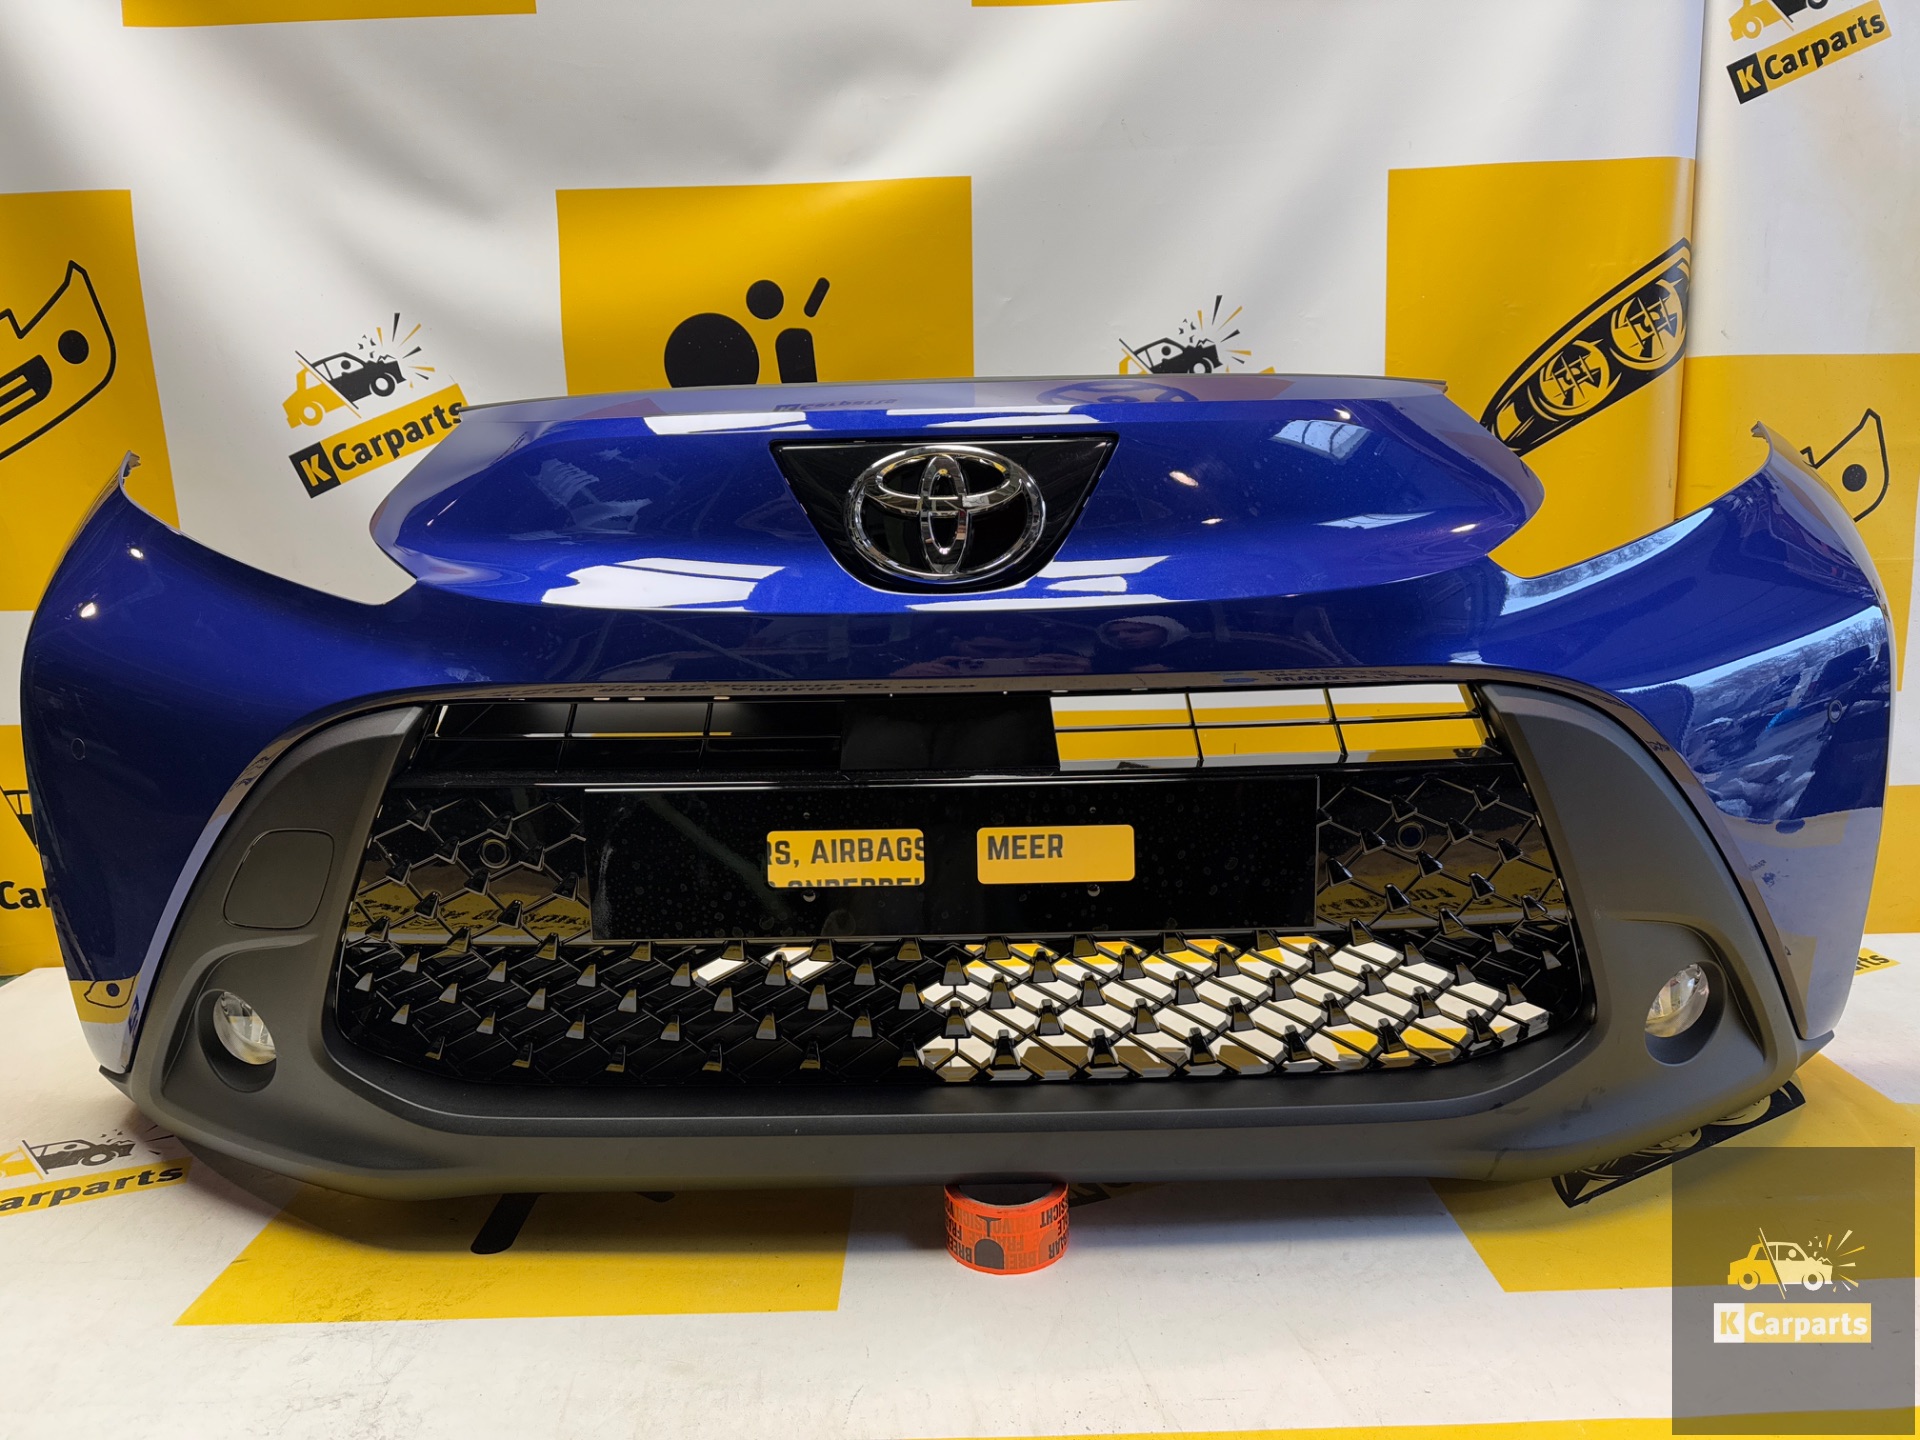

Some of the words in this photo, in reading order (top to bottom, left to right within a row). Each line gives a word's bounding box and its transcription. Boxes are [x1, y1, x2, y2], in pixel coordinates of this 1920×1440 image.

[1764, 14, 1885, 80] Carparts
[332, 402, 462, 471] Carparts
[987, 833, 1064, 860] MEER
